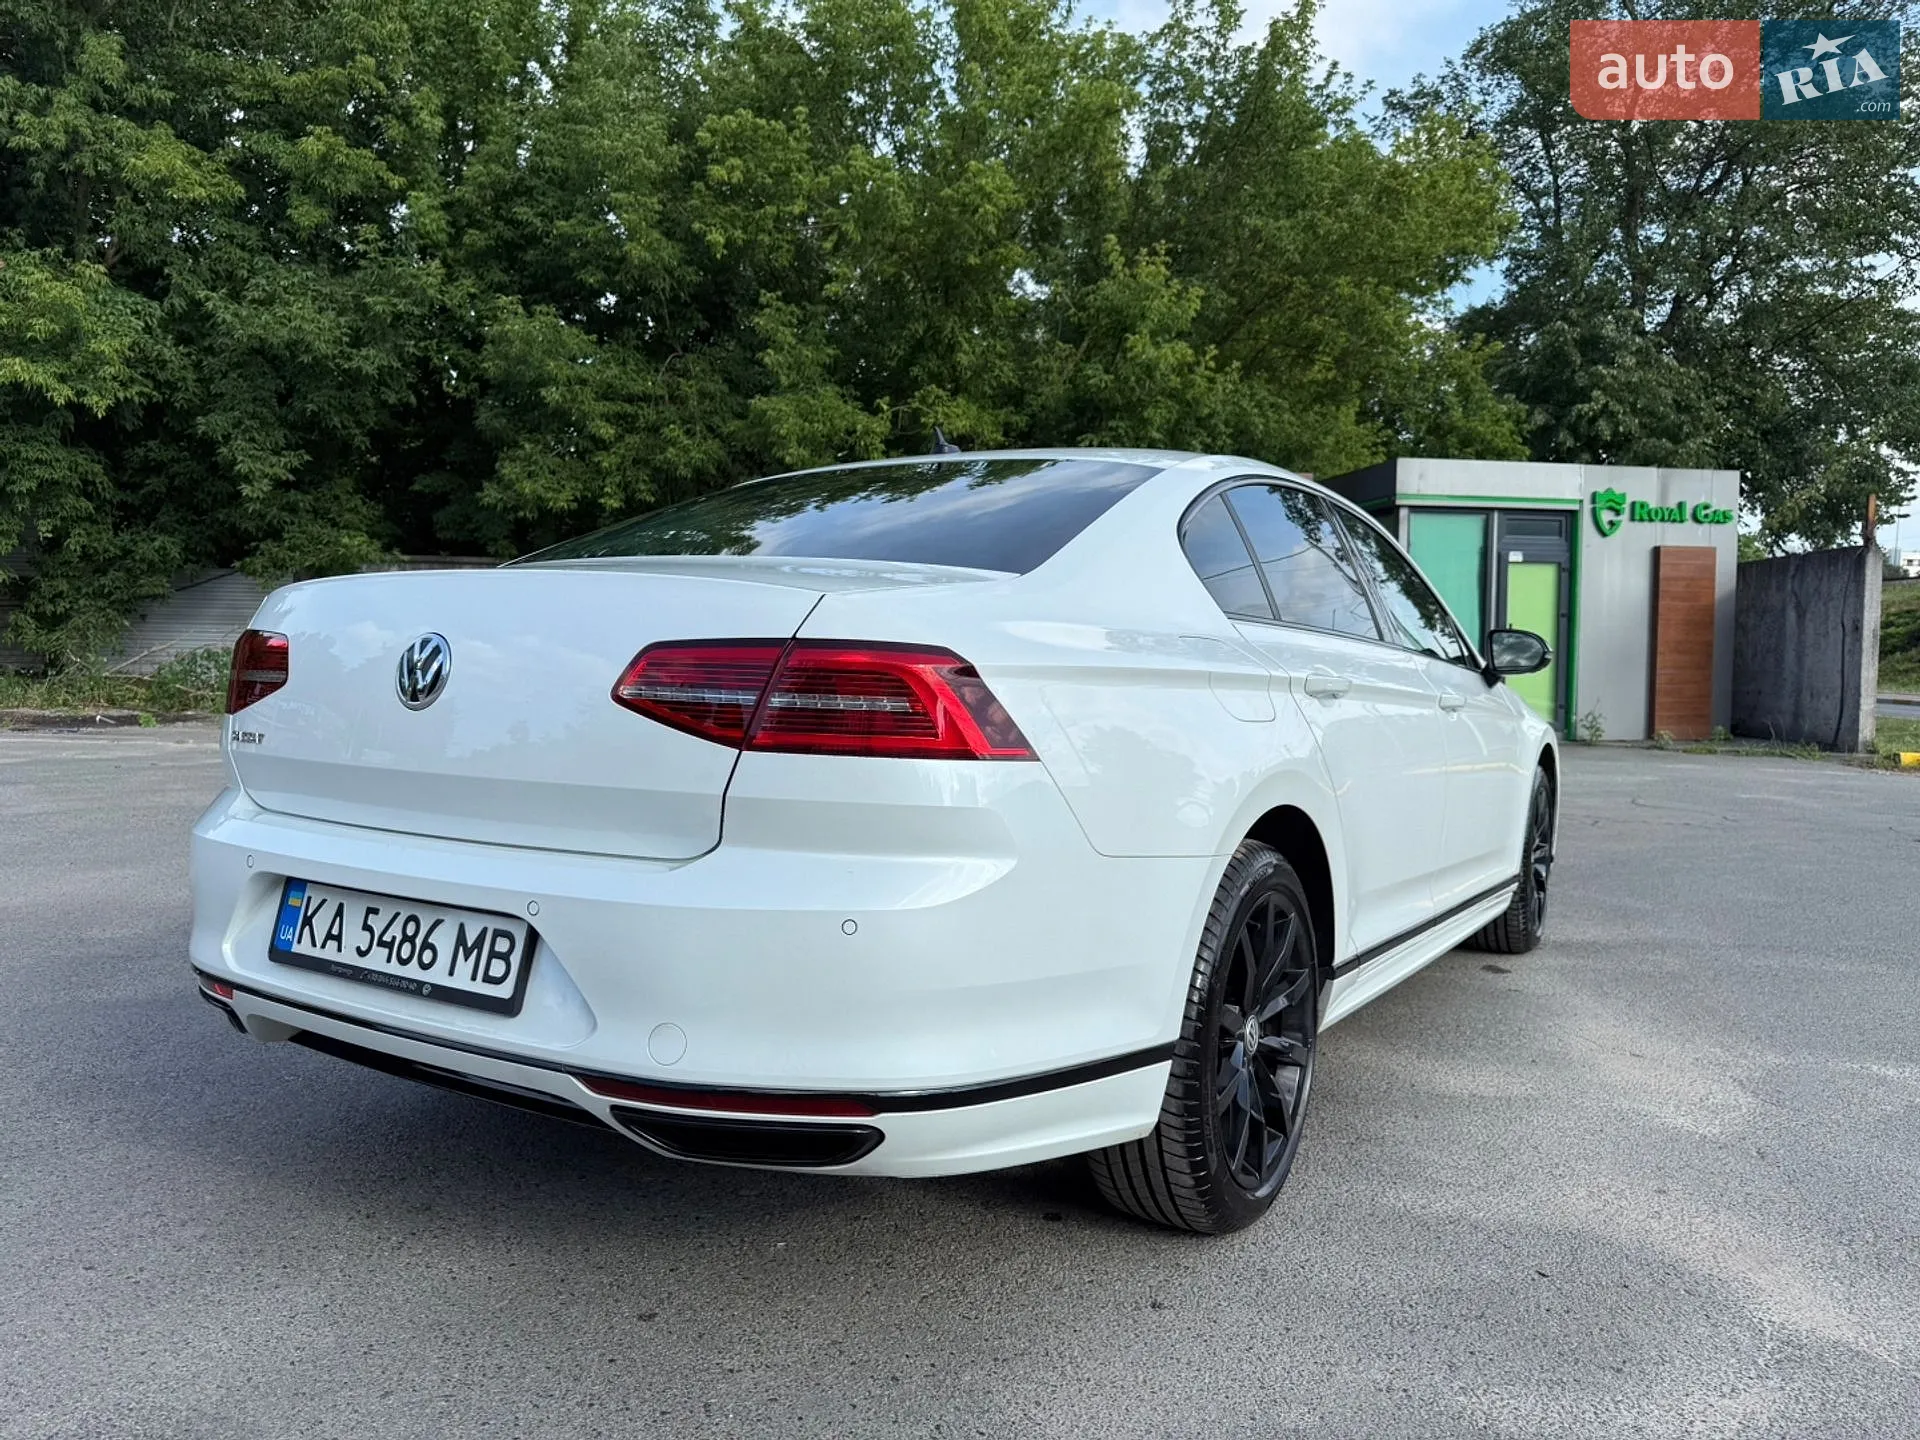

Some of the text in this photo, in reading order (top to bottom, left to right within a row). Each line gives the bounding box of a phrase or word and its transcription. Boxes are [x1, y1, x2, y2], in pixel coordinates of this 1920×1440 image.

[280, 924, 293, 942] UA
[297, 896, 516, 985] KA 5486 MB
